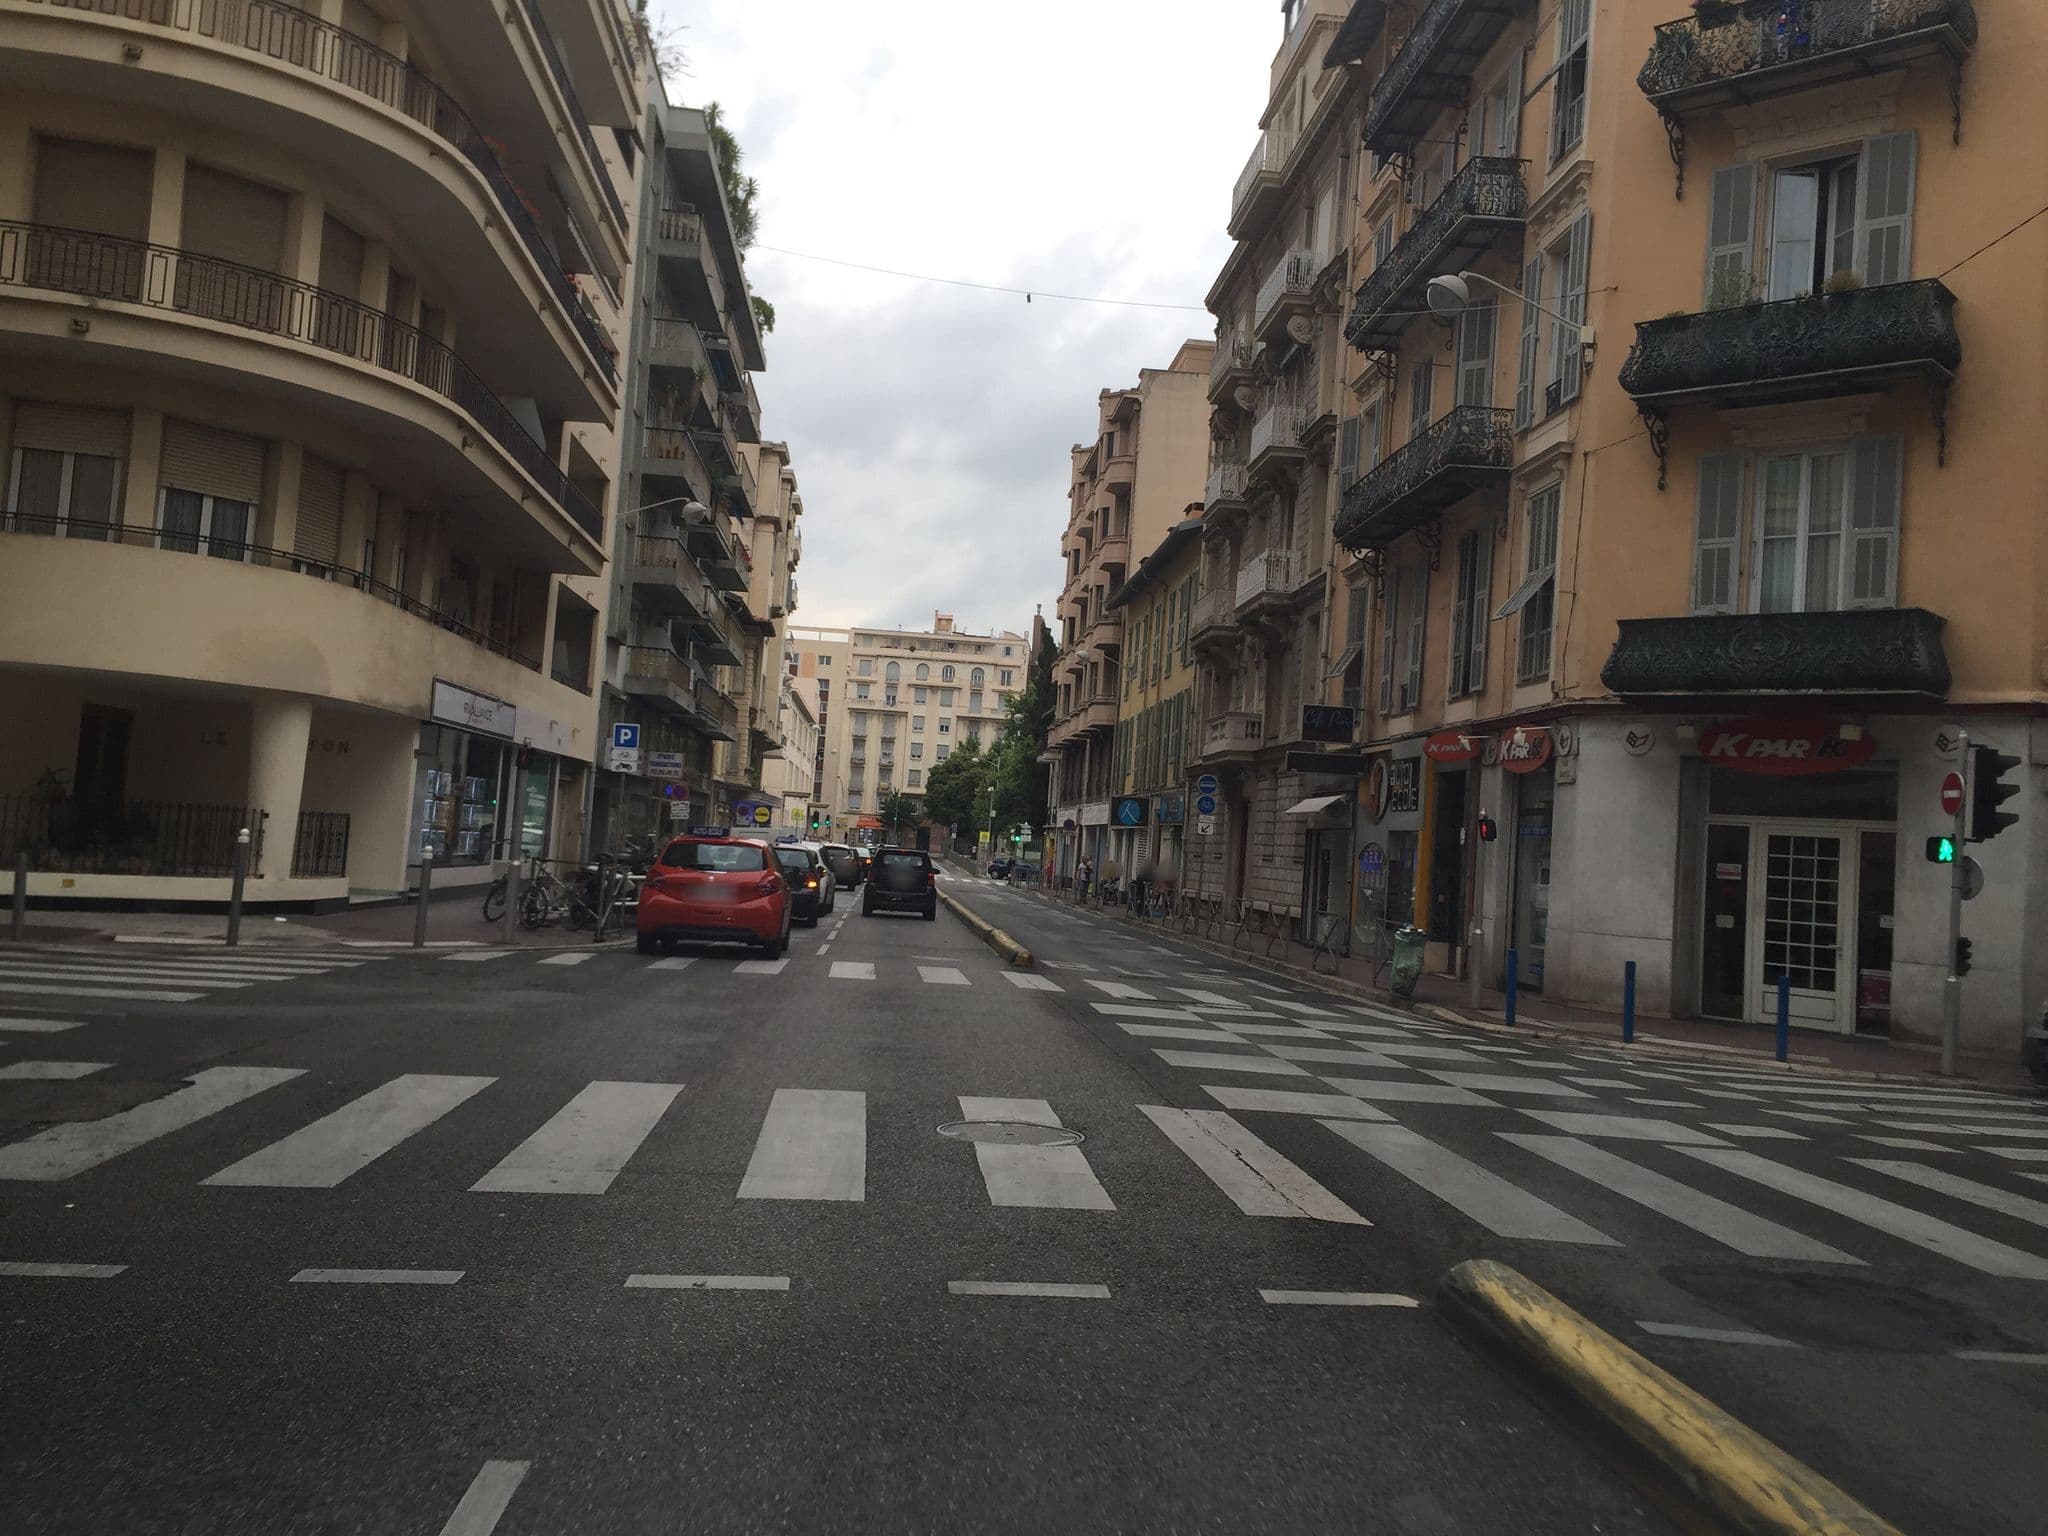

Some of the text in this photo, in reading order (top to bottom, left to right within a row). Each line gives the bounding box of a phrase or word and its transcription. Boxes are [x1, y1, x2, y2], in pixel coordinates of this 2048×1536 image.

[620, 728, 632, 744] P
[1429, 743, 1440, 752] K
[1500, 740, 1511, 760] K
[1710, 733, 1750, 757] K
[1747, 739, 1811, 758] PAR
